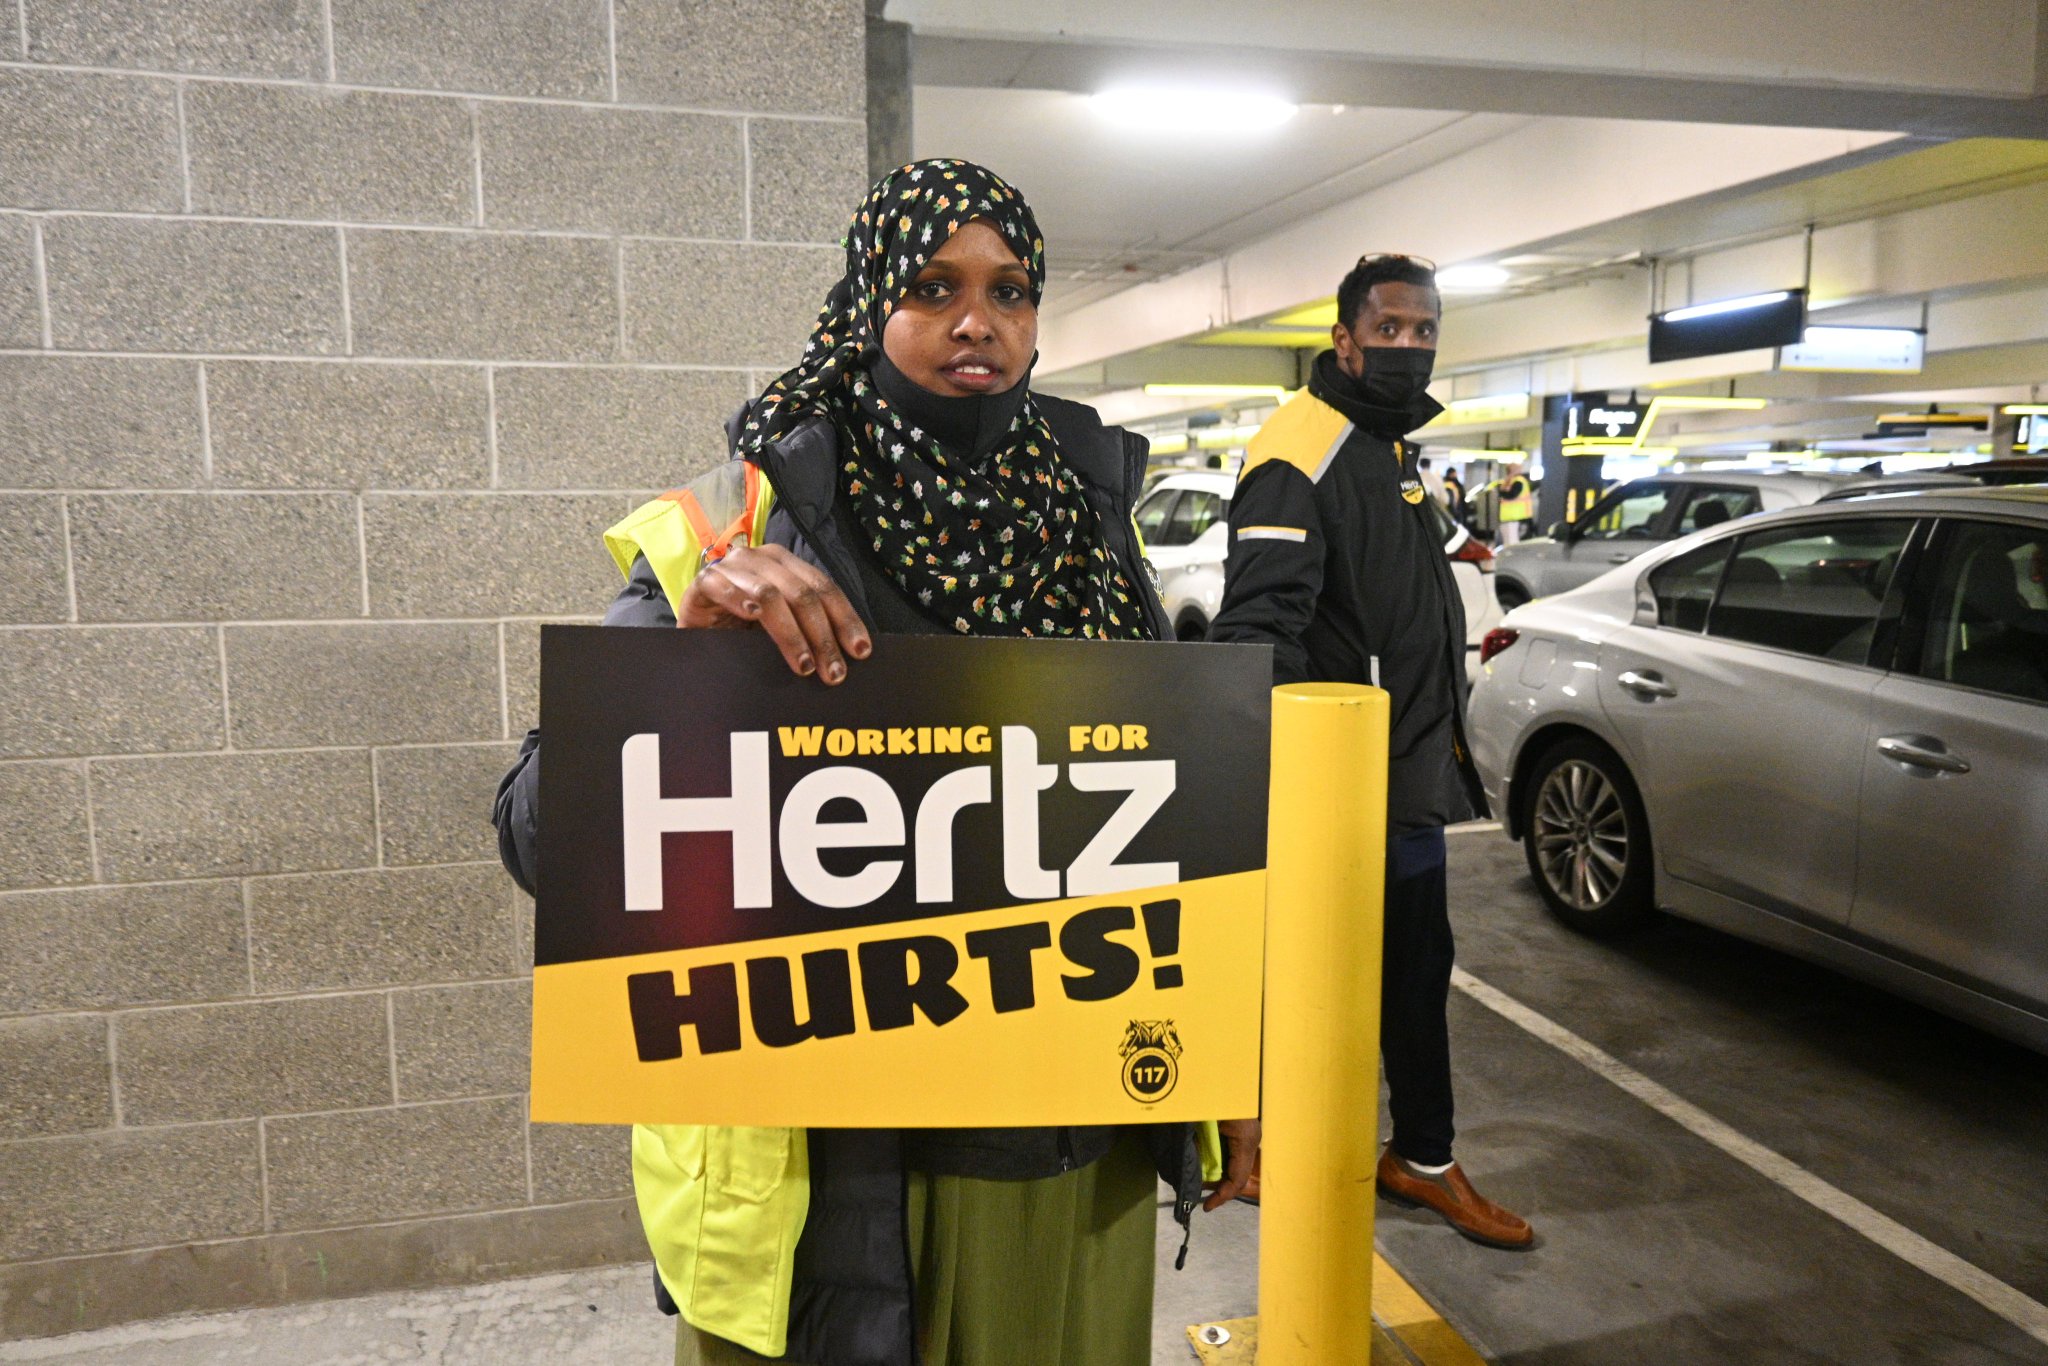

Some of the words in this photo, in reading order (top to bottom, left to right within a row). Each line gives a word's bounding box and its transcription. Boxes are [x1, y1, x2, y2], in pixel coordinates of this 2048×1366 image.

[777, 723, 992, 758] WORKING
[1069, 723, 1149, 753] FOR
[620, 724, 1181, 912] Hertz
[626, 897, 1184, 1063] HURTS!
[1133, 1066, 1167, 1084] 117
